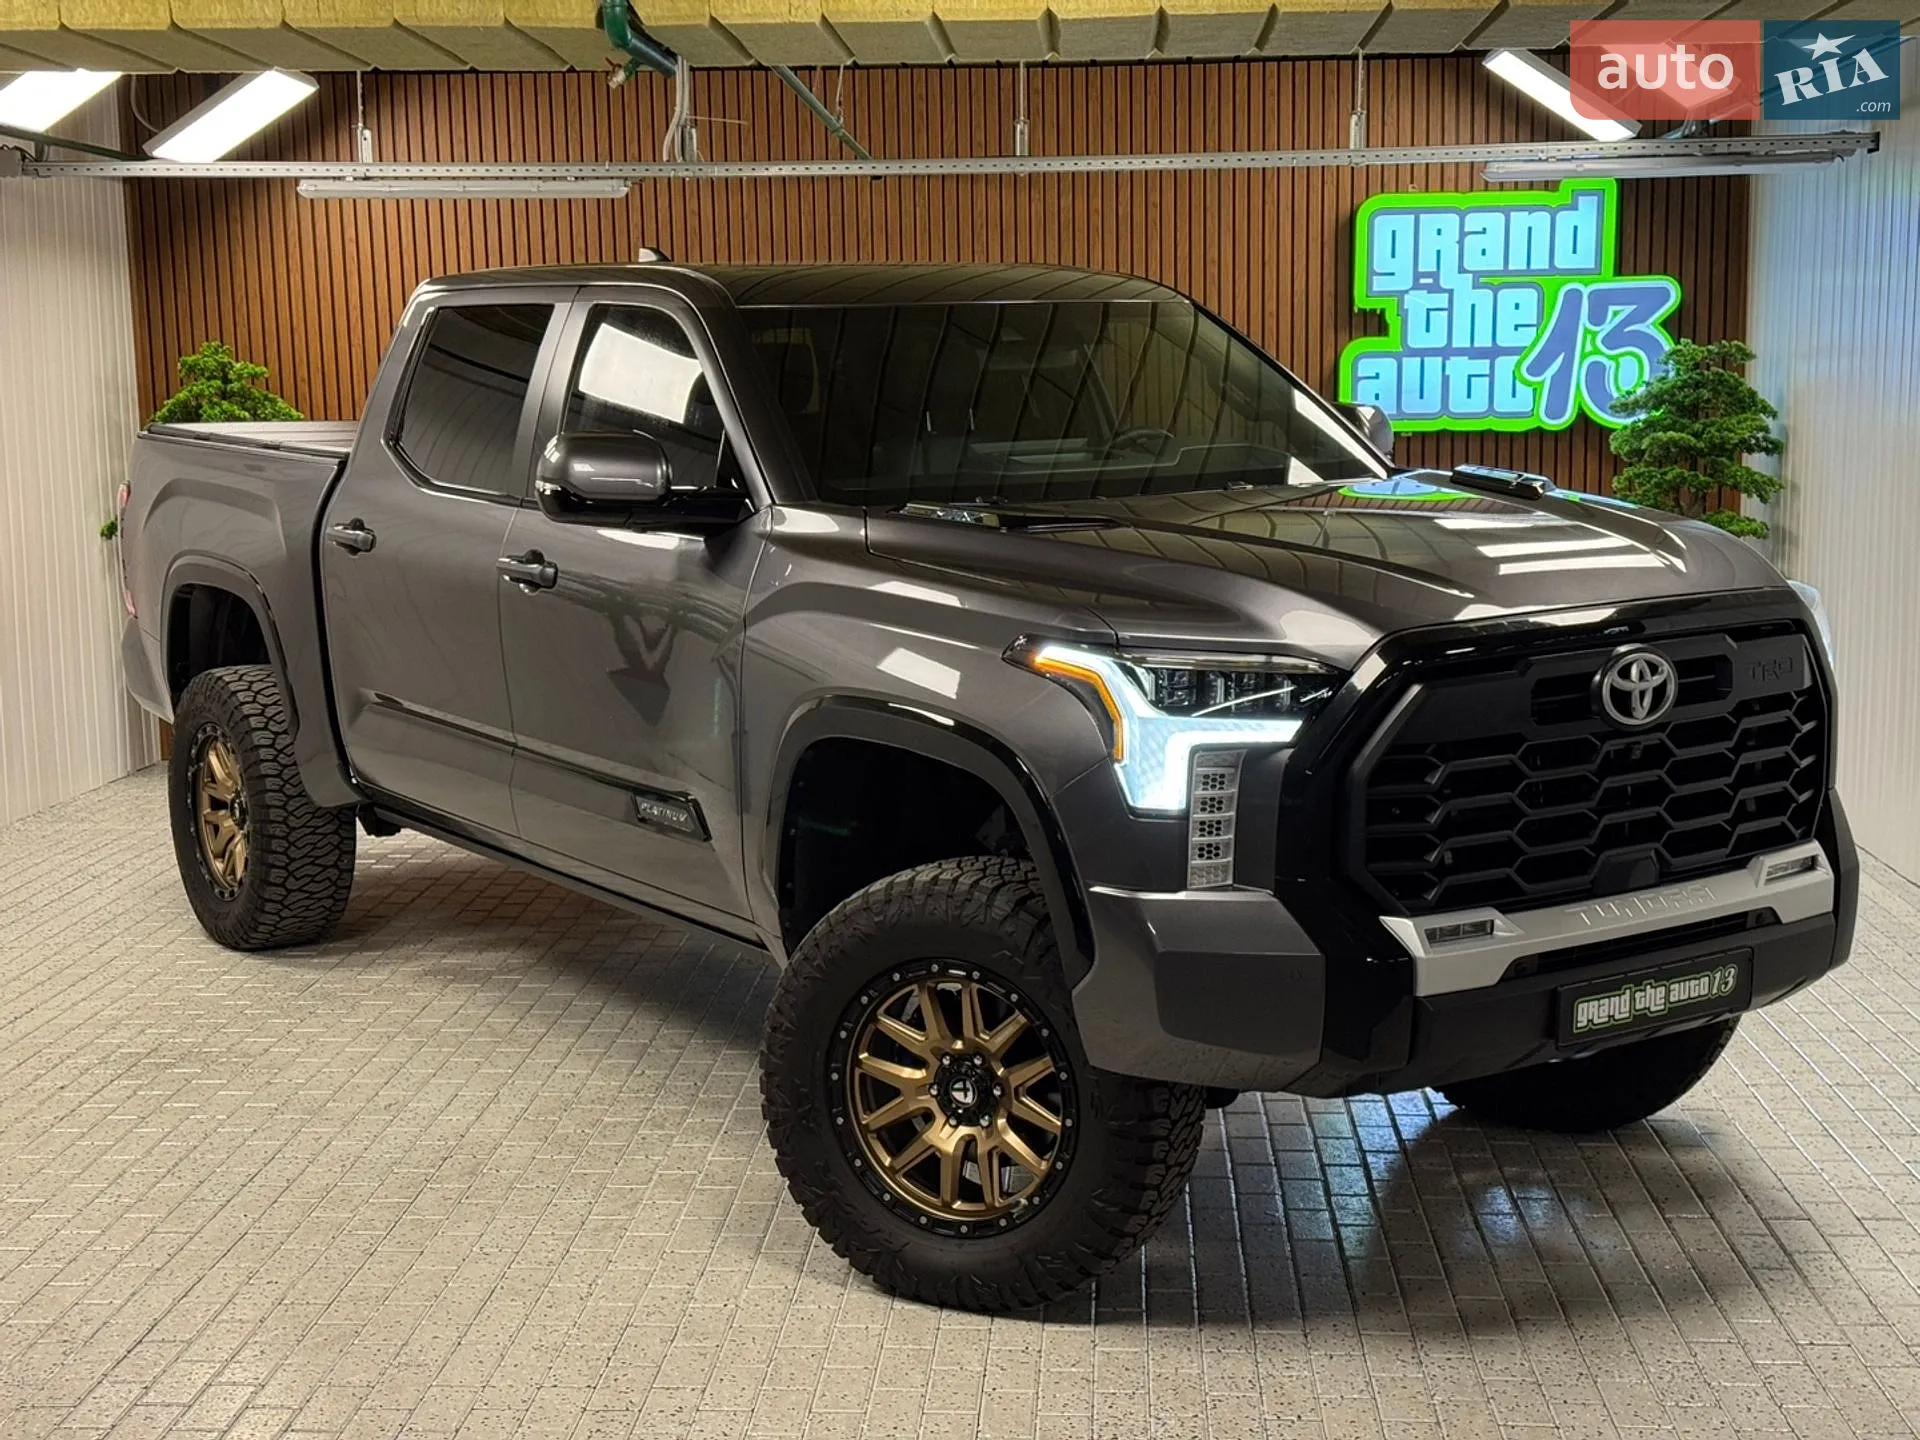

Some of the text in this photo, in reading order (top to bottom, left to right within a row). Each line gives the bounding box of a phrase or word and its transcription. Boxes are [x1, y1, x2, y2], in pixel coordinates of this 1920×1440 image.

[1371, 195, 1600, 291] grand
[1403, 272, 1539, 349] the
[1356, 283, 1680, 424] auto 13
[1565, 886, 1718, 925] TUNDRA
[1576, 967, 1737, 1028] grand the auto 13
